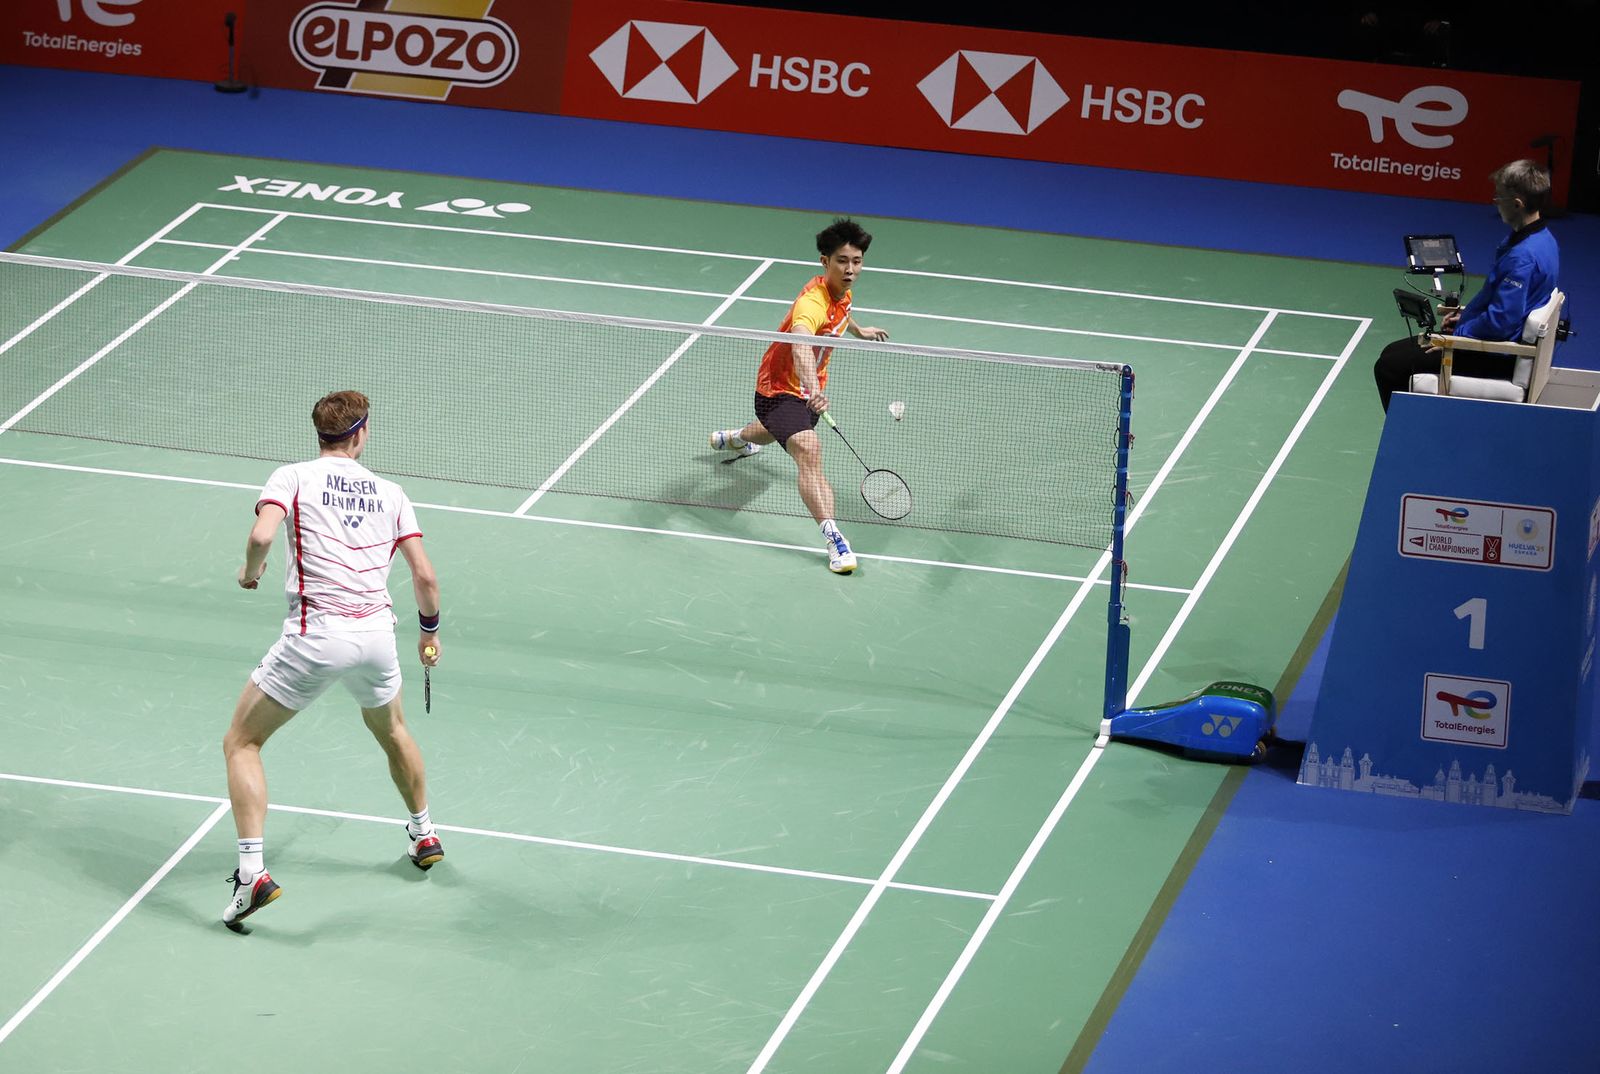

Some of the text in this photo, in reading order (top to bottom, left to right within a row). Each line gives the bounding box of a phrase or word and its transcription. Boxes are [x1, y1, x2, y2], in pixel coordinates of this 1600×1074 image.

[23, 31, 142, 58] TotalEnergies
[749, 53, 871, 98] HSBC
[1080, 84, 1206, 129] HSBC
[1330, 152, 1462, 181] TotalEnergies
[218, 175, 405, 209] YONEX
[326, 474, 377, 495] AXELSEN
[322, 492, 384, 513] DENMARK
[1428, 543, 1480, 556] CHAMPIONSHIPS
[1429, 535, 1452, 545] WORLD
[1453, 598, 1487, 649] 1
[1212, 684, 1265, 698] YONEX
[1434, 720, 1496, 735] TotalEnergies
